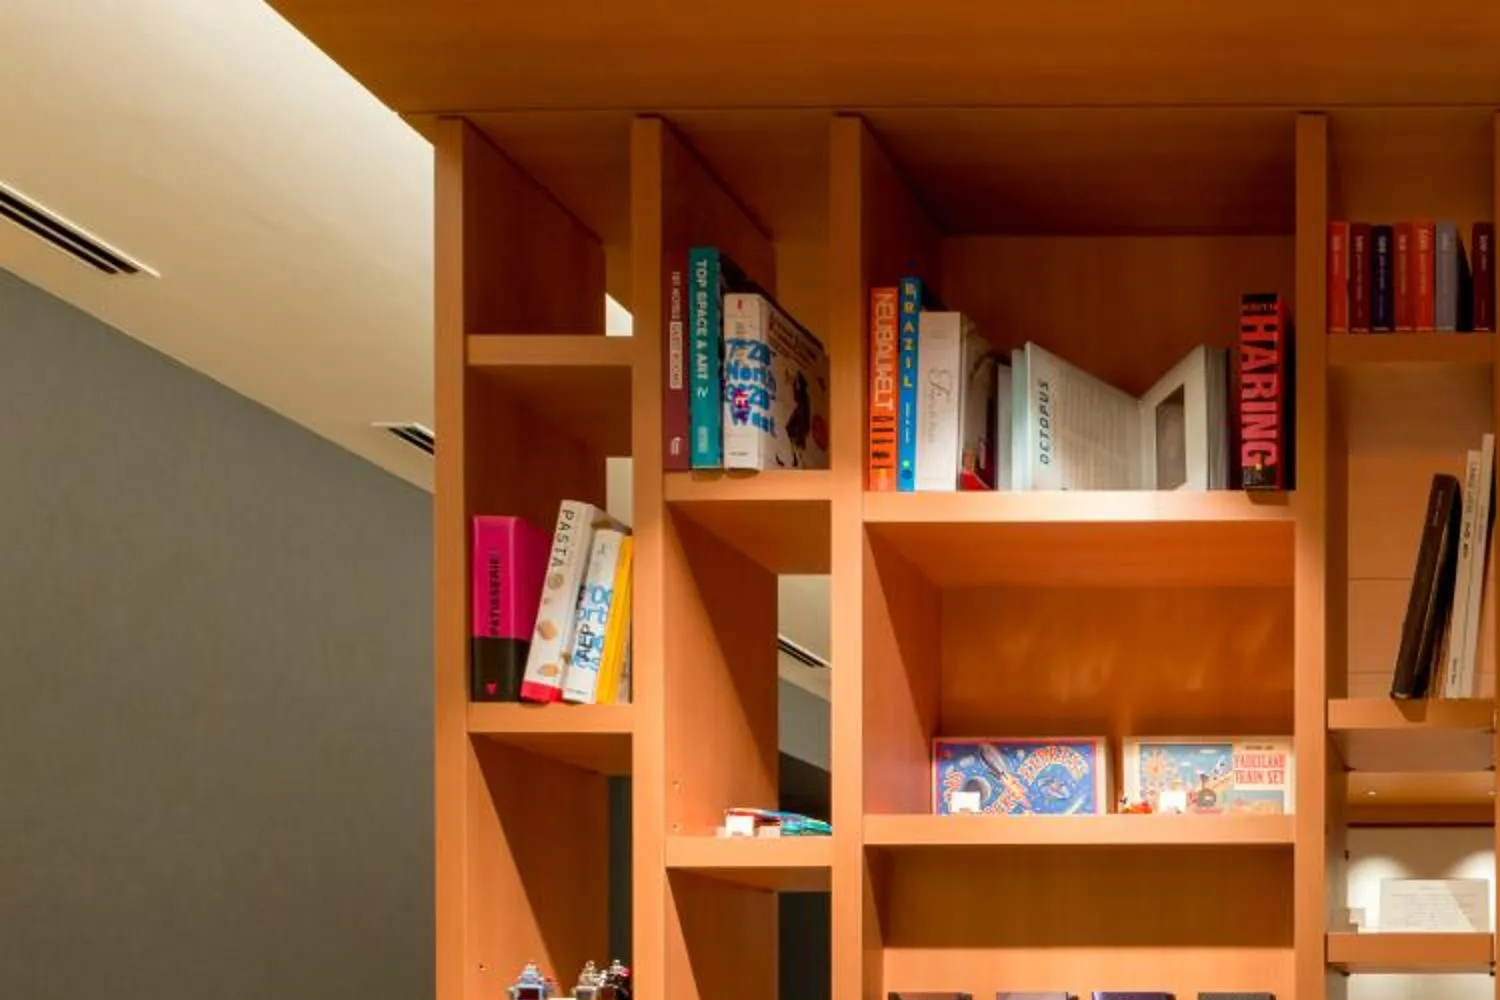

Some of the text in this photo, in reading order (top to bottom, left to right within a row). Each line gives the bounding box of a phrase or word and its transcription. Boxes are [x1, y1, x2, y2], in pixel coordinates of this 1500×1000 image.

[696, 259, 708, 287] TOP
[696, 291, 708, 337] SPACE
[903, 282, 917, 388] BRAZIL
[696, 353, 708, 380] ART
[696, 386, 708, 399] 2
[1241, 315, 1278, 467] HARING
[1038, 378, 1051, 466] OCTOPUS
[551, 509, 574, 568] PASTA
[1234, 769, 1285, 785] TRAIN SET
